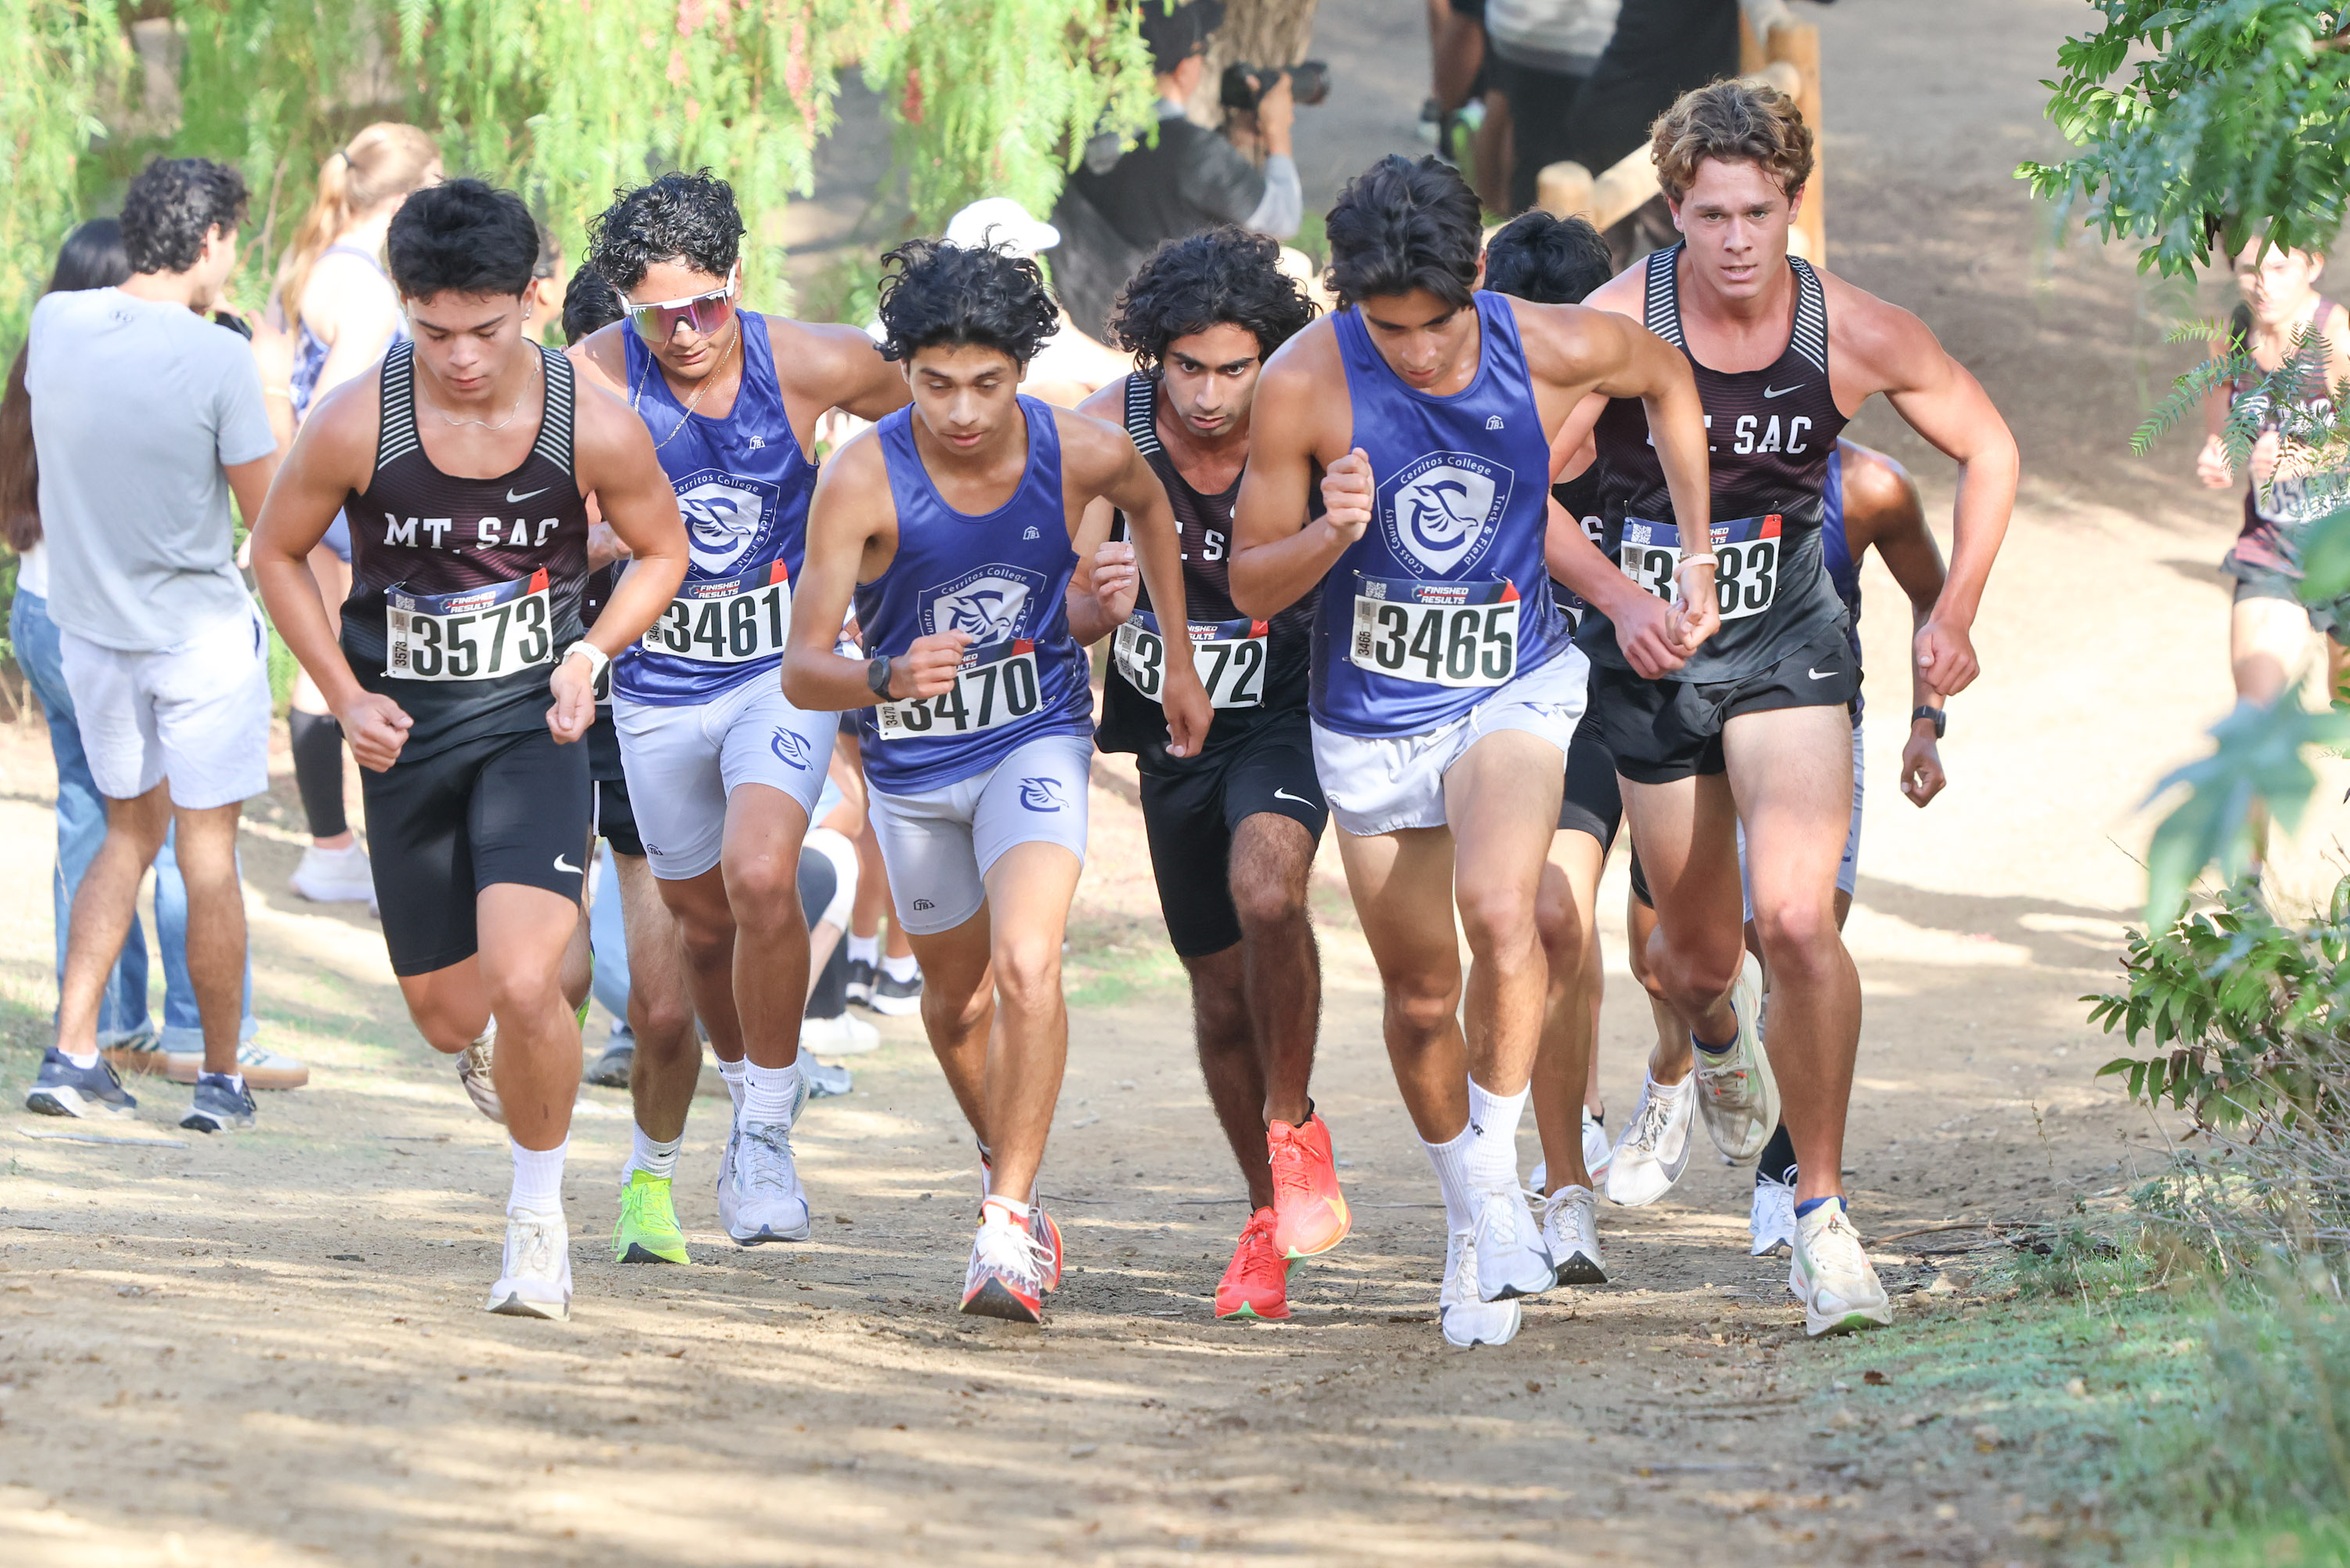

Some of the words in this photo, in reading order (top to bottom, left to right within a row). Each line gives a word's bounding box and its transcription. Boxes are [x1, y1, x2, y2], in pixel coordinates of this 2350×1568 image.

[1733, 414, 1812, 455] SAC
[1400, 456, 1443, 484] Cerritos
[1447, 456, 1492, 475] College
[717, 474, 759, 493] College
[1487, 494, 1505, 522] Track
[383, 512, 461, 554] MT.
[475, 516, 560, 550] SAC
[1385, 508, 1401, 550] Country
[1484, 525, 1493, 534] &
[1400, 549, 1425, 574] Cross
[1464, 538, 1488, 566] Field
[700, 579, 741, 591] FINISHED
[941, 571, 984, 595] Cerritos
[986, 567, 1028, 583] College
[1424, 585, 1470, 595] FINISHED
[1643, 542, 1776, 615] 383
[450, 600, 495, 613] RESULTS
[452, 590, 497, 605] FINISHED
[698, 588, 739, 599] RESULTS
[1420, 595, 1466, 604] RESULTS
[663, 587, 783, 657] 3461
[924, 608, 934, 634] untry
[411, 595, 549, 677] 3573
[1189, 632, 1216, 640] SULTS
[1357, 631, 1371, 656] 3465
[1374, 604, 1515, 680] 3465
[394, 641, 408, 667] 3573
[1134, 634, 1263, 704] 372
[901, 657, 1037, 731] 3470
[882, 706, 898, 726] 3470
